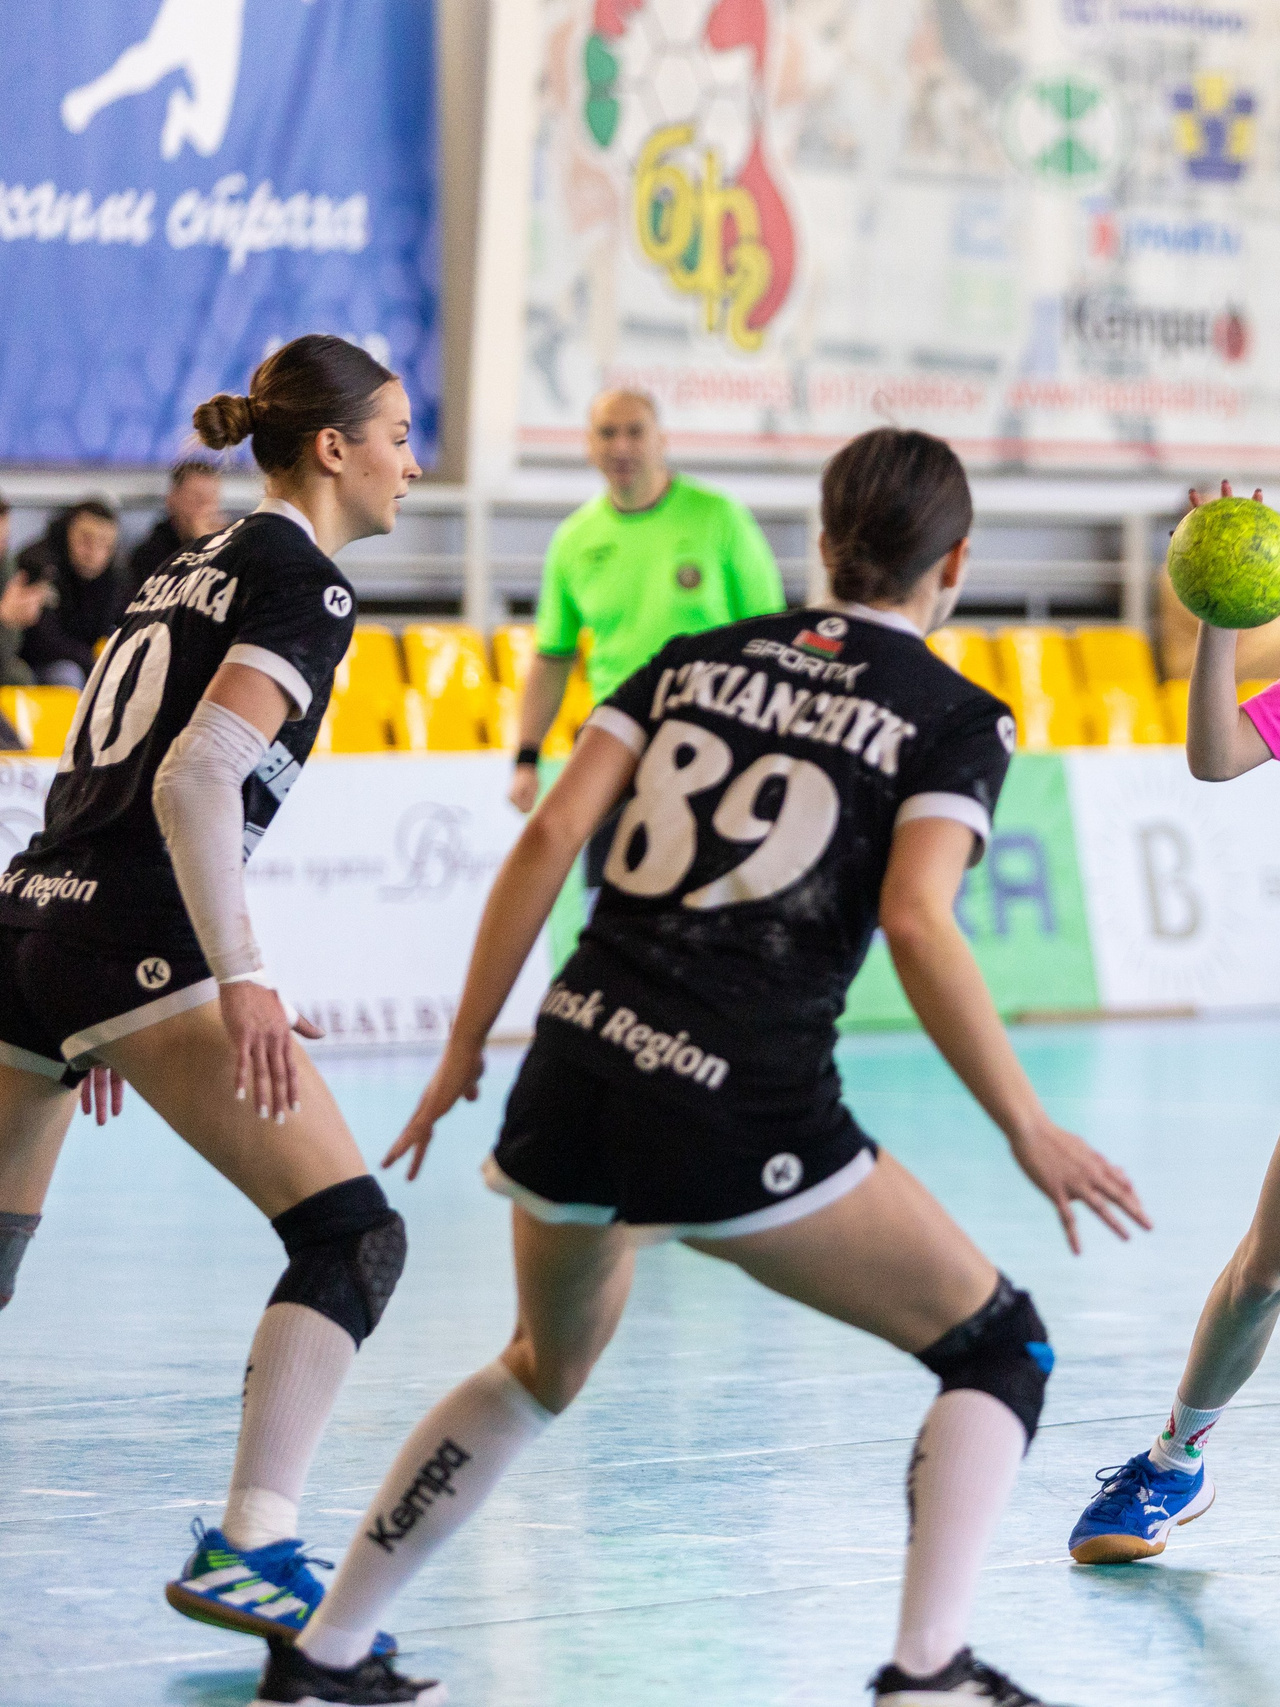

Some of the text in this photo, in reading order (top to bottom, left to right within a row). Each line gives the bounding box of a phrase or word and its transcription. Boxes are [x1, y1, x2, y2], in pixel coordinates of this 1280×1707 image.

[603, 718, 841, 912] 89
[20, 869, 99, 908] Region
[599, 1006, 731, 1092] Region
[365, 1437, 473, 1555] Kempa
